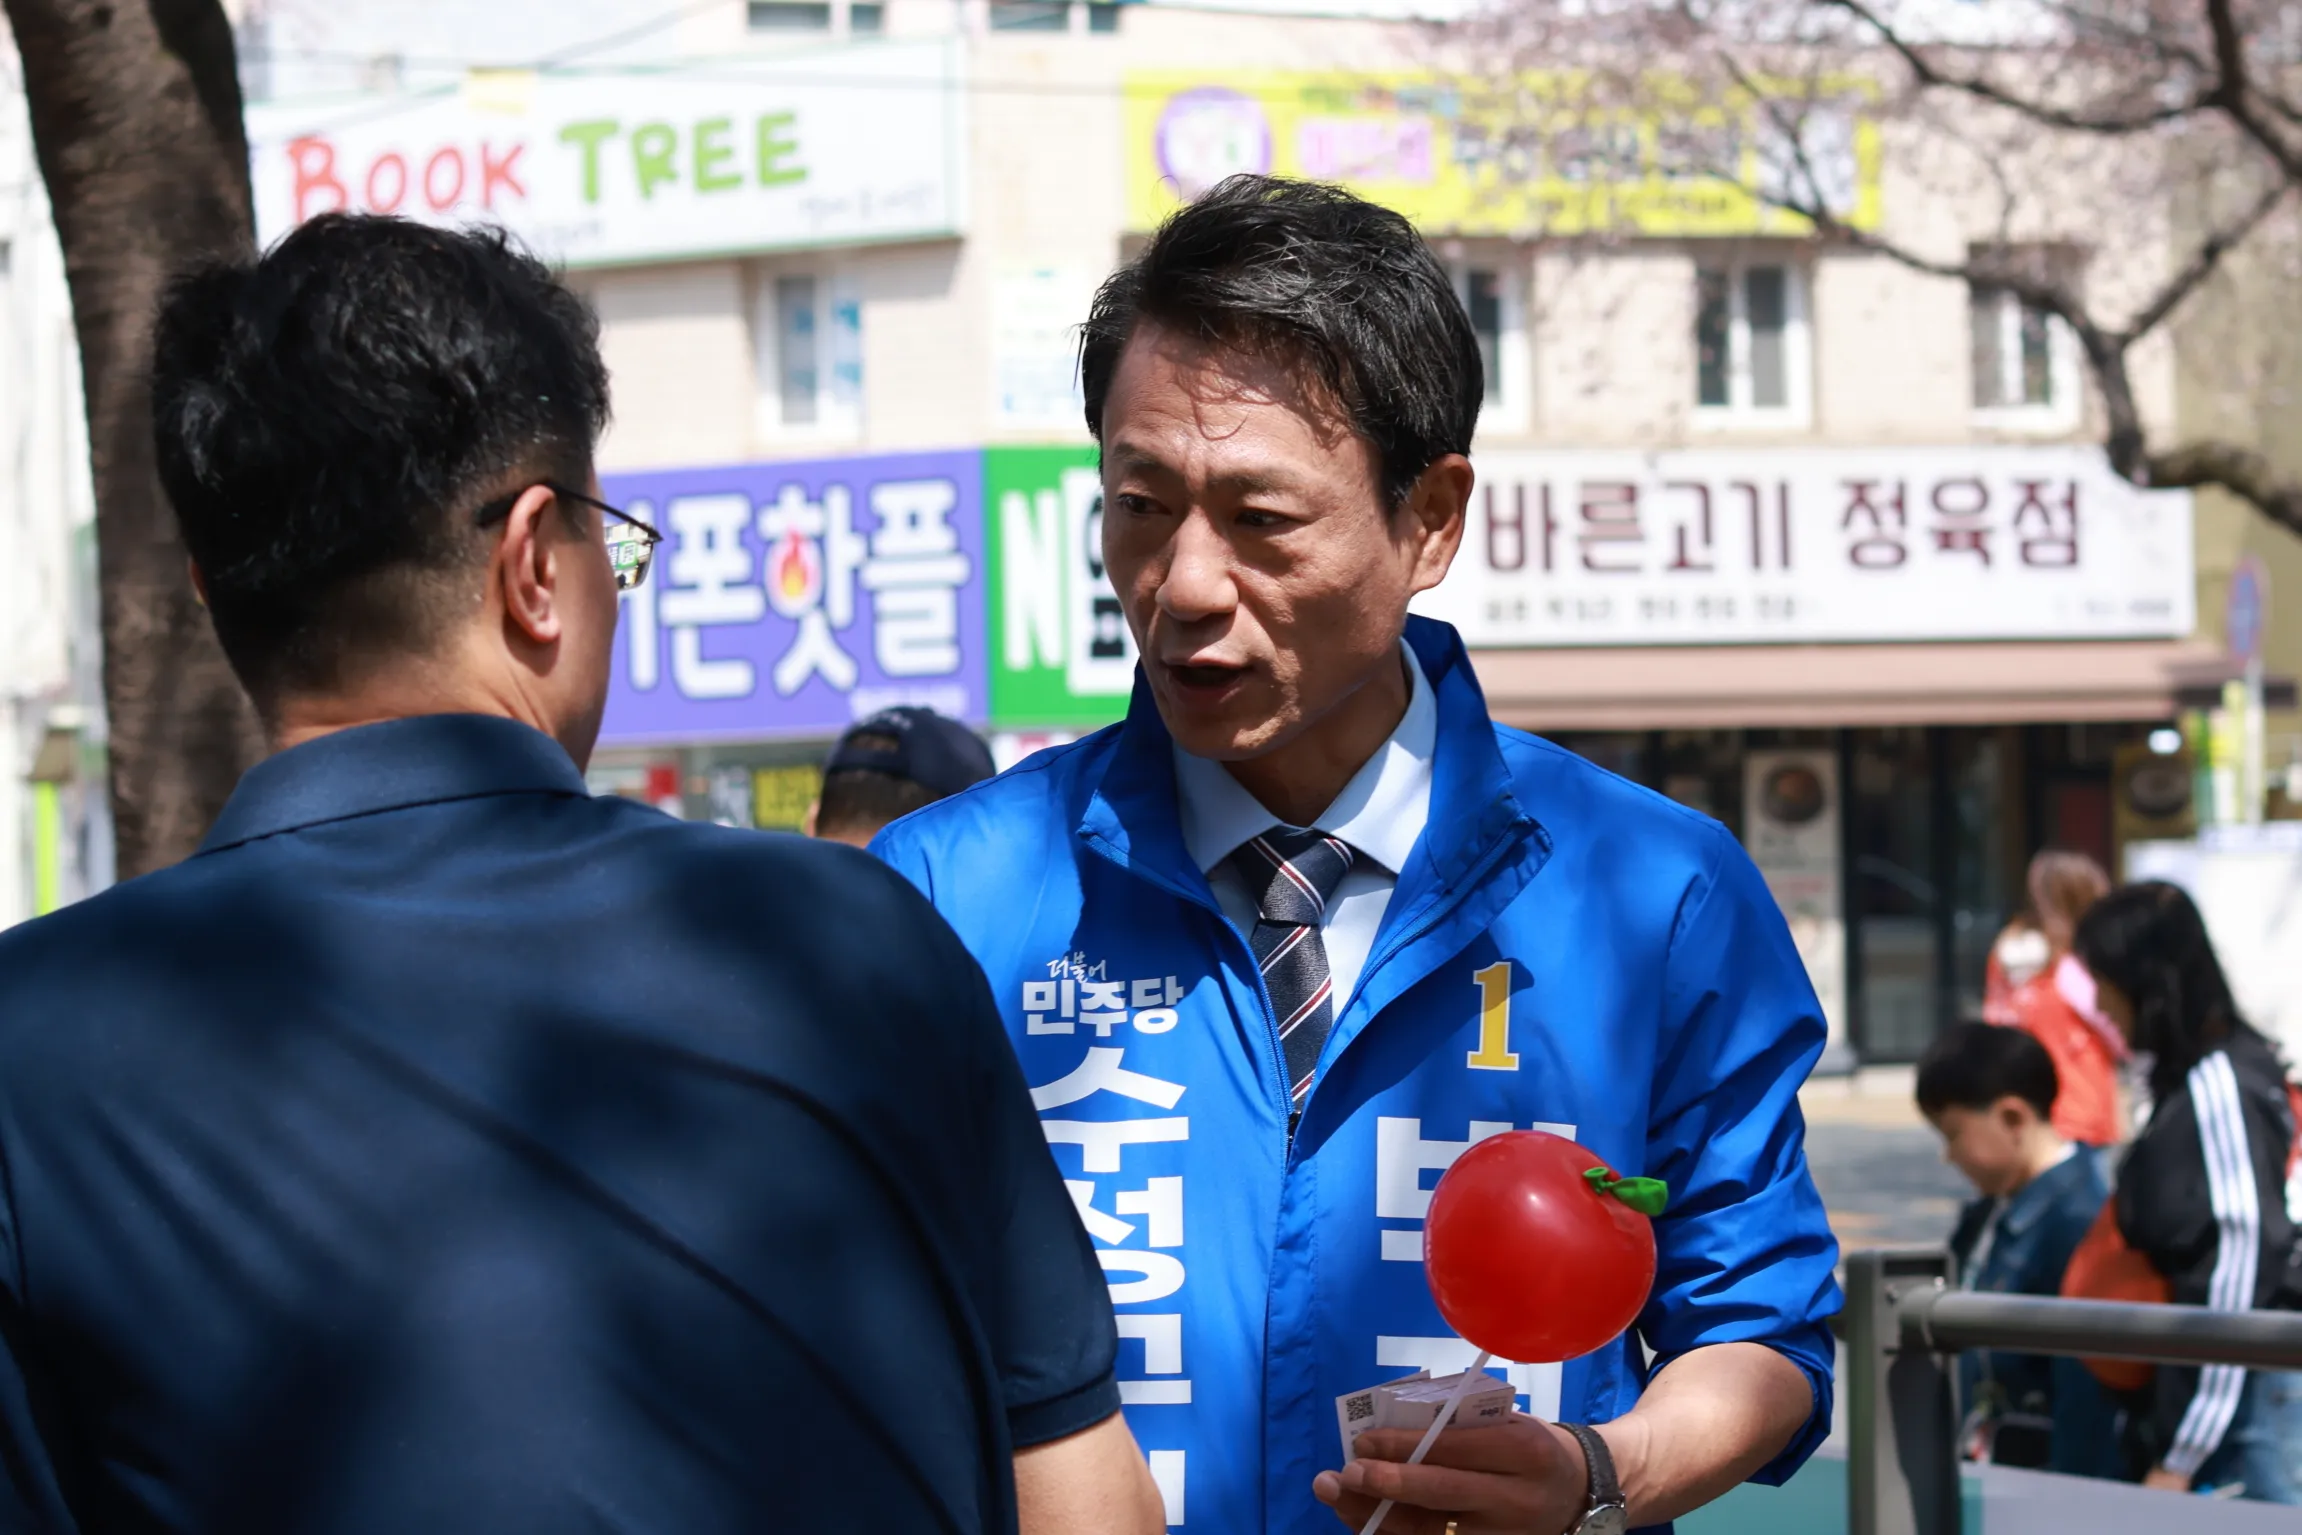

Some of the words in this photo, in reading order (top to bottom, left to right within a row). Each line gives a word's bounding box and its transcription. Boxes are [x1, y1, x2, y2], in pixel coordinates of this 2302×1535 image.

[287, 136, 528, 224] BOOK
[558, 112, 810, 205] TREE
[1484, 479, 1794, 572] 바른고기
[1837, 476, 2080, 568] 정육점
[1022, 975, 1185, 1037] 민주당
[1046, 950, 1107, 984] 더불어
[1466, 961, 1520, 1071] 1
[1028, 1046, 1192, 1535] 수성
